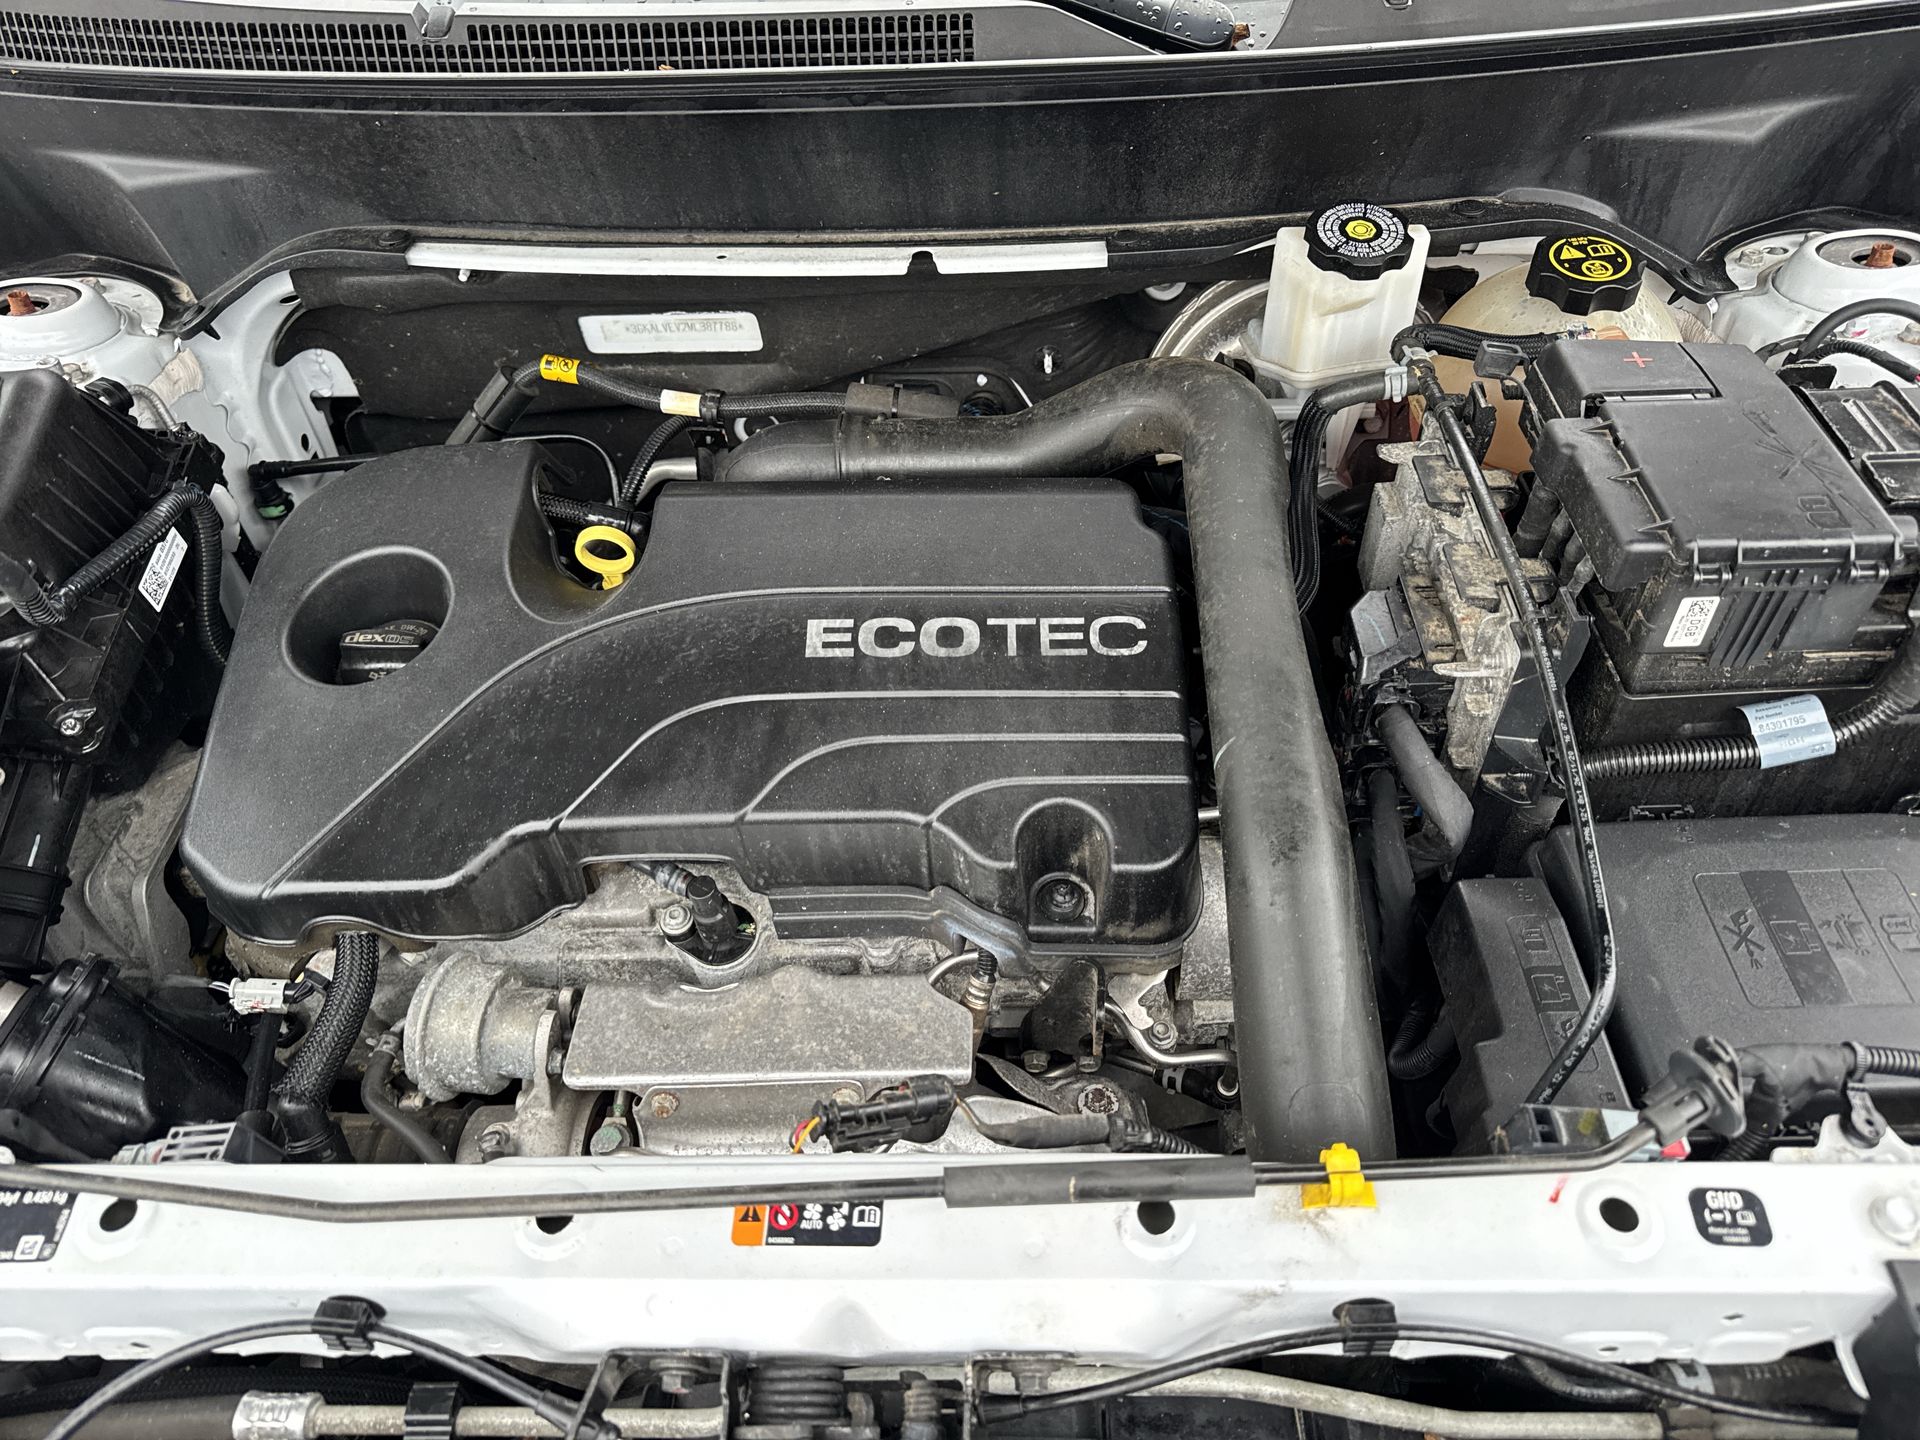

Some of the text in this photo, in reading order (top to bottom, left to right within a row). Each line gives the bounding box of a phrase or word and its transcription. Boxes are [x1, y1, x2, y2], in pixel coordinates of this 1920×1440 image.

[344, 632, 415, 645] dexos
[805, 615, 1149, 658] ECOTEC
[1758, 715, 1807, 733] 84301795
[1705, 1189, 1744, 1211] GND
[800, 1219, 823, 1230] AUTO
